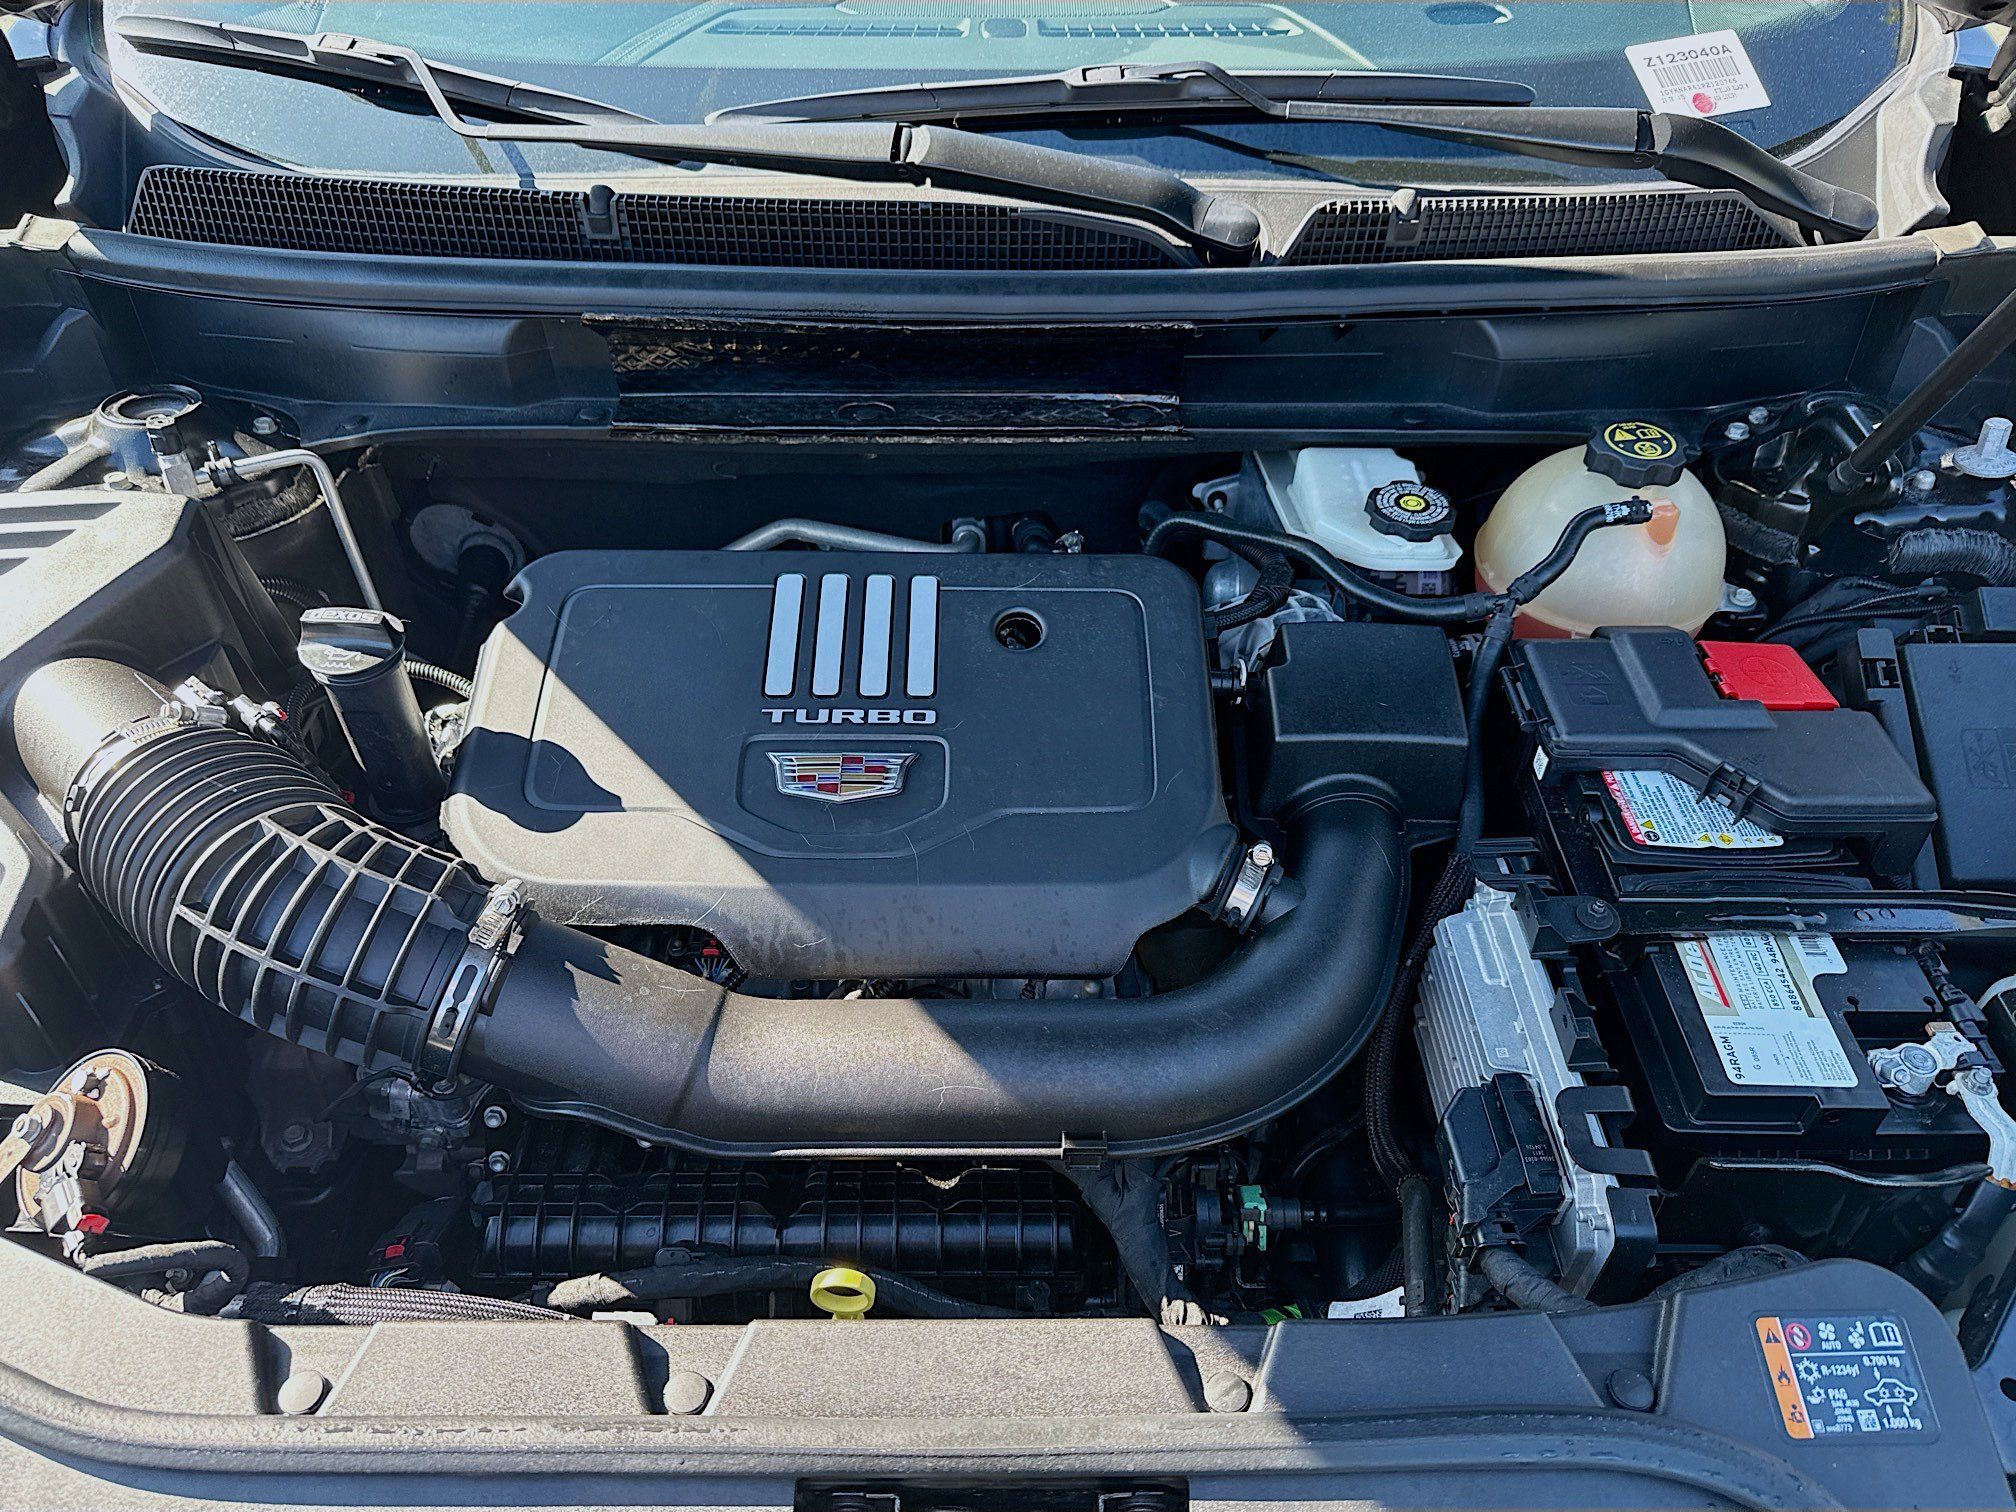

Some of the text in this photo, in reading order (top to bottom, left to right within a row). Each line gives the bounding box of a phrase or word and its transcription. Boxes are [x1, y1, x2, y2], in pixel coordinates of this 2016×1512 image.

[1643, 44, 1732, 67] Z123040A
[309, 609, 379, 621] dexos
[761, 708, 936, 724] TURBO
[1730, 938, 1740, 958] MANTEN
[1760, 934, 1780, 963] 94RAG
[1684, 942, 1722, 1004] ACDe
[1720, 948, 1743, 992] MAINTENANCE
[1751, 952, 1763, 974] 140 RC
[1764, 981, 1779, 1006] 850 CCA
[1775, 968, 1802, 1011] 88864542
[1720, 1036, 1745, 1080] 94RAGM
[1822, 1341, 1842, 1350] AUTO
[1862, 1355, 1900, 1368] 0.700 kg
[1828, 1388, 1848, 1400] PAG
[1908, 1417, 1922, 1430] kg
